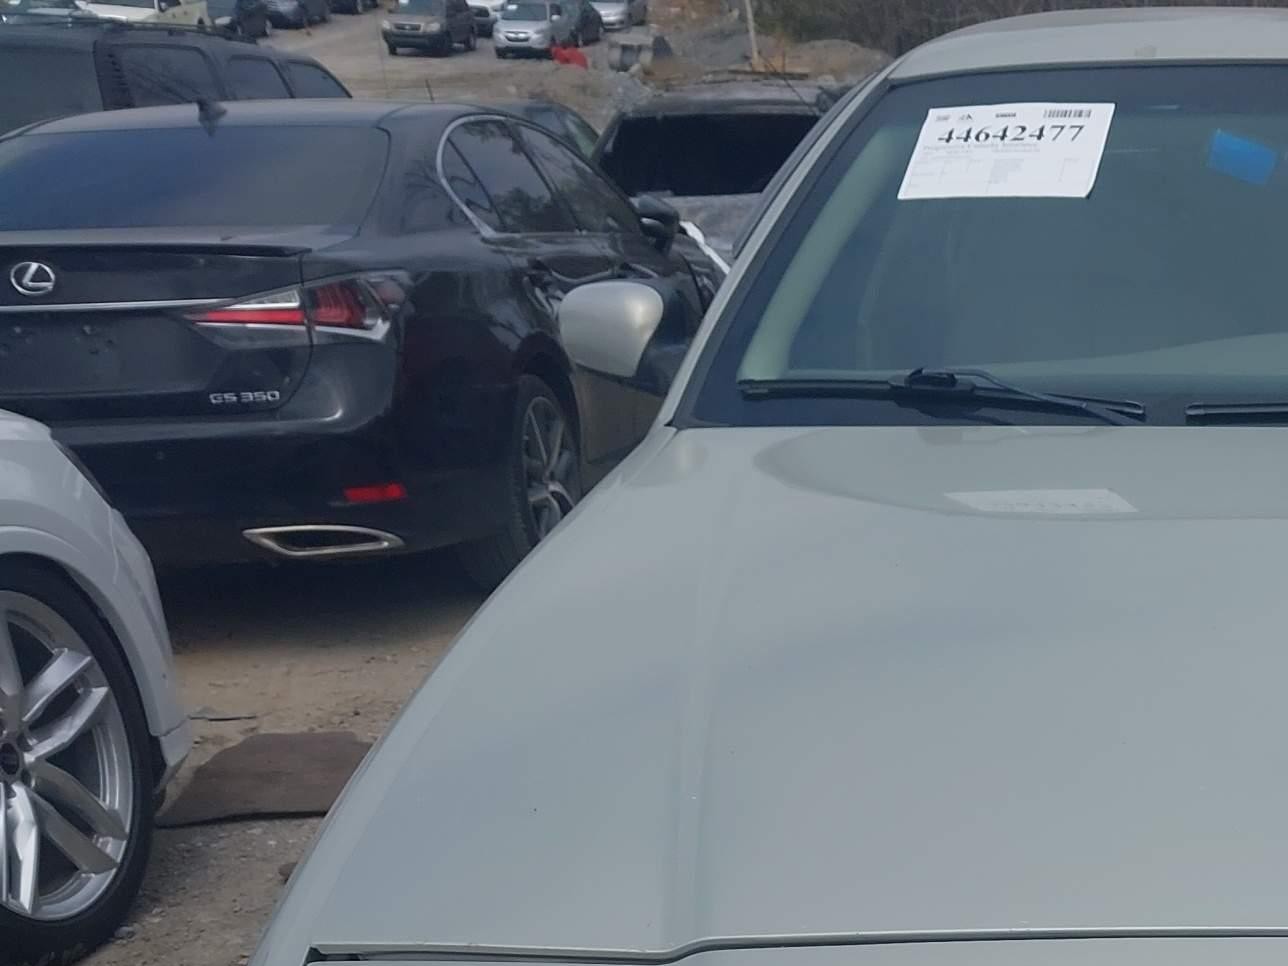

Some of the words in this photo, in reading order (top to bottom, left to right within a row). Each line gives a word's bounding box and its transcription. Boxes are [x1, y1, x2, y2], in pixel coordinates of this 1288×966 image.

[937, 124, 1085, 144] 44642477
[209, 393, 237, 403] GS
[240, 391, 280, 401] 350
